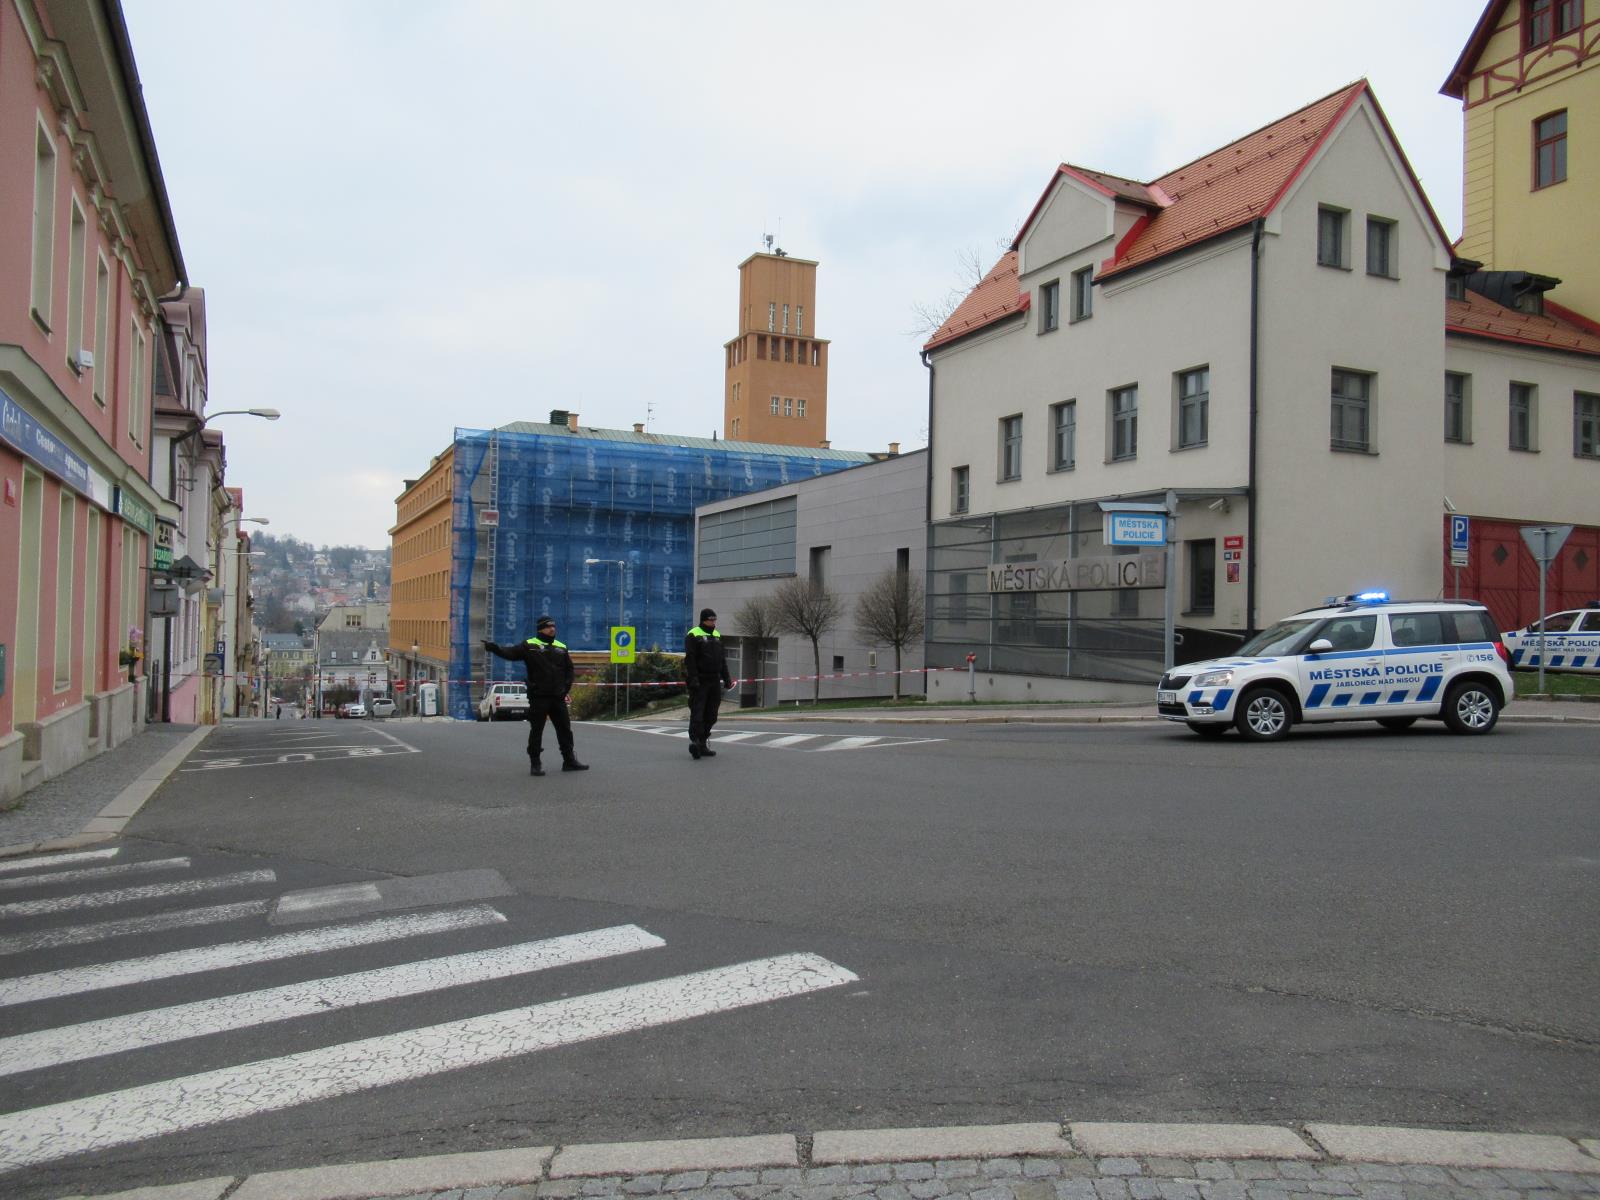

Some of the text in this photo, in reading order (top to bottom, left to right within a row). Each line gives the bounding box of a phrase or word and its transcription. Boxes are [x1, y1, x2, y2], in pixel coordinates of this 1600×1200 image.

[508, 480, 519, 519] Cemix
[1118, 517, 1159, 529] MĚSTSKÁ
[1455, 519, 1465, 540] P
[1122, 530, 1156, 539] POLICIE
[507, 532, 518, 571] Cemix
[543, 545, 553, 584] Cemix
[990, 559, 1160, 592] MĚSTSKÁ POLICIE
[506, 591, 517, 630] Cemix
[582, 605, 592, 642] Cemix
[1521, 638, 1565, 647] MĚSSKÁ
[1475, 653, 1494, 661] 156
[1310, 663, 1444, 681] MĚSTSKÁ POLICIE
[1397, 676, 1420, 684] NISOU
